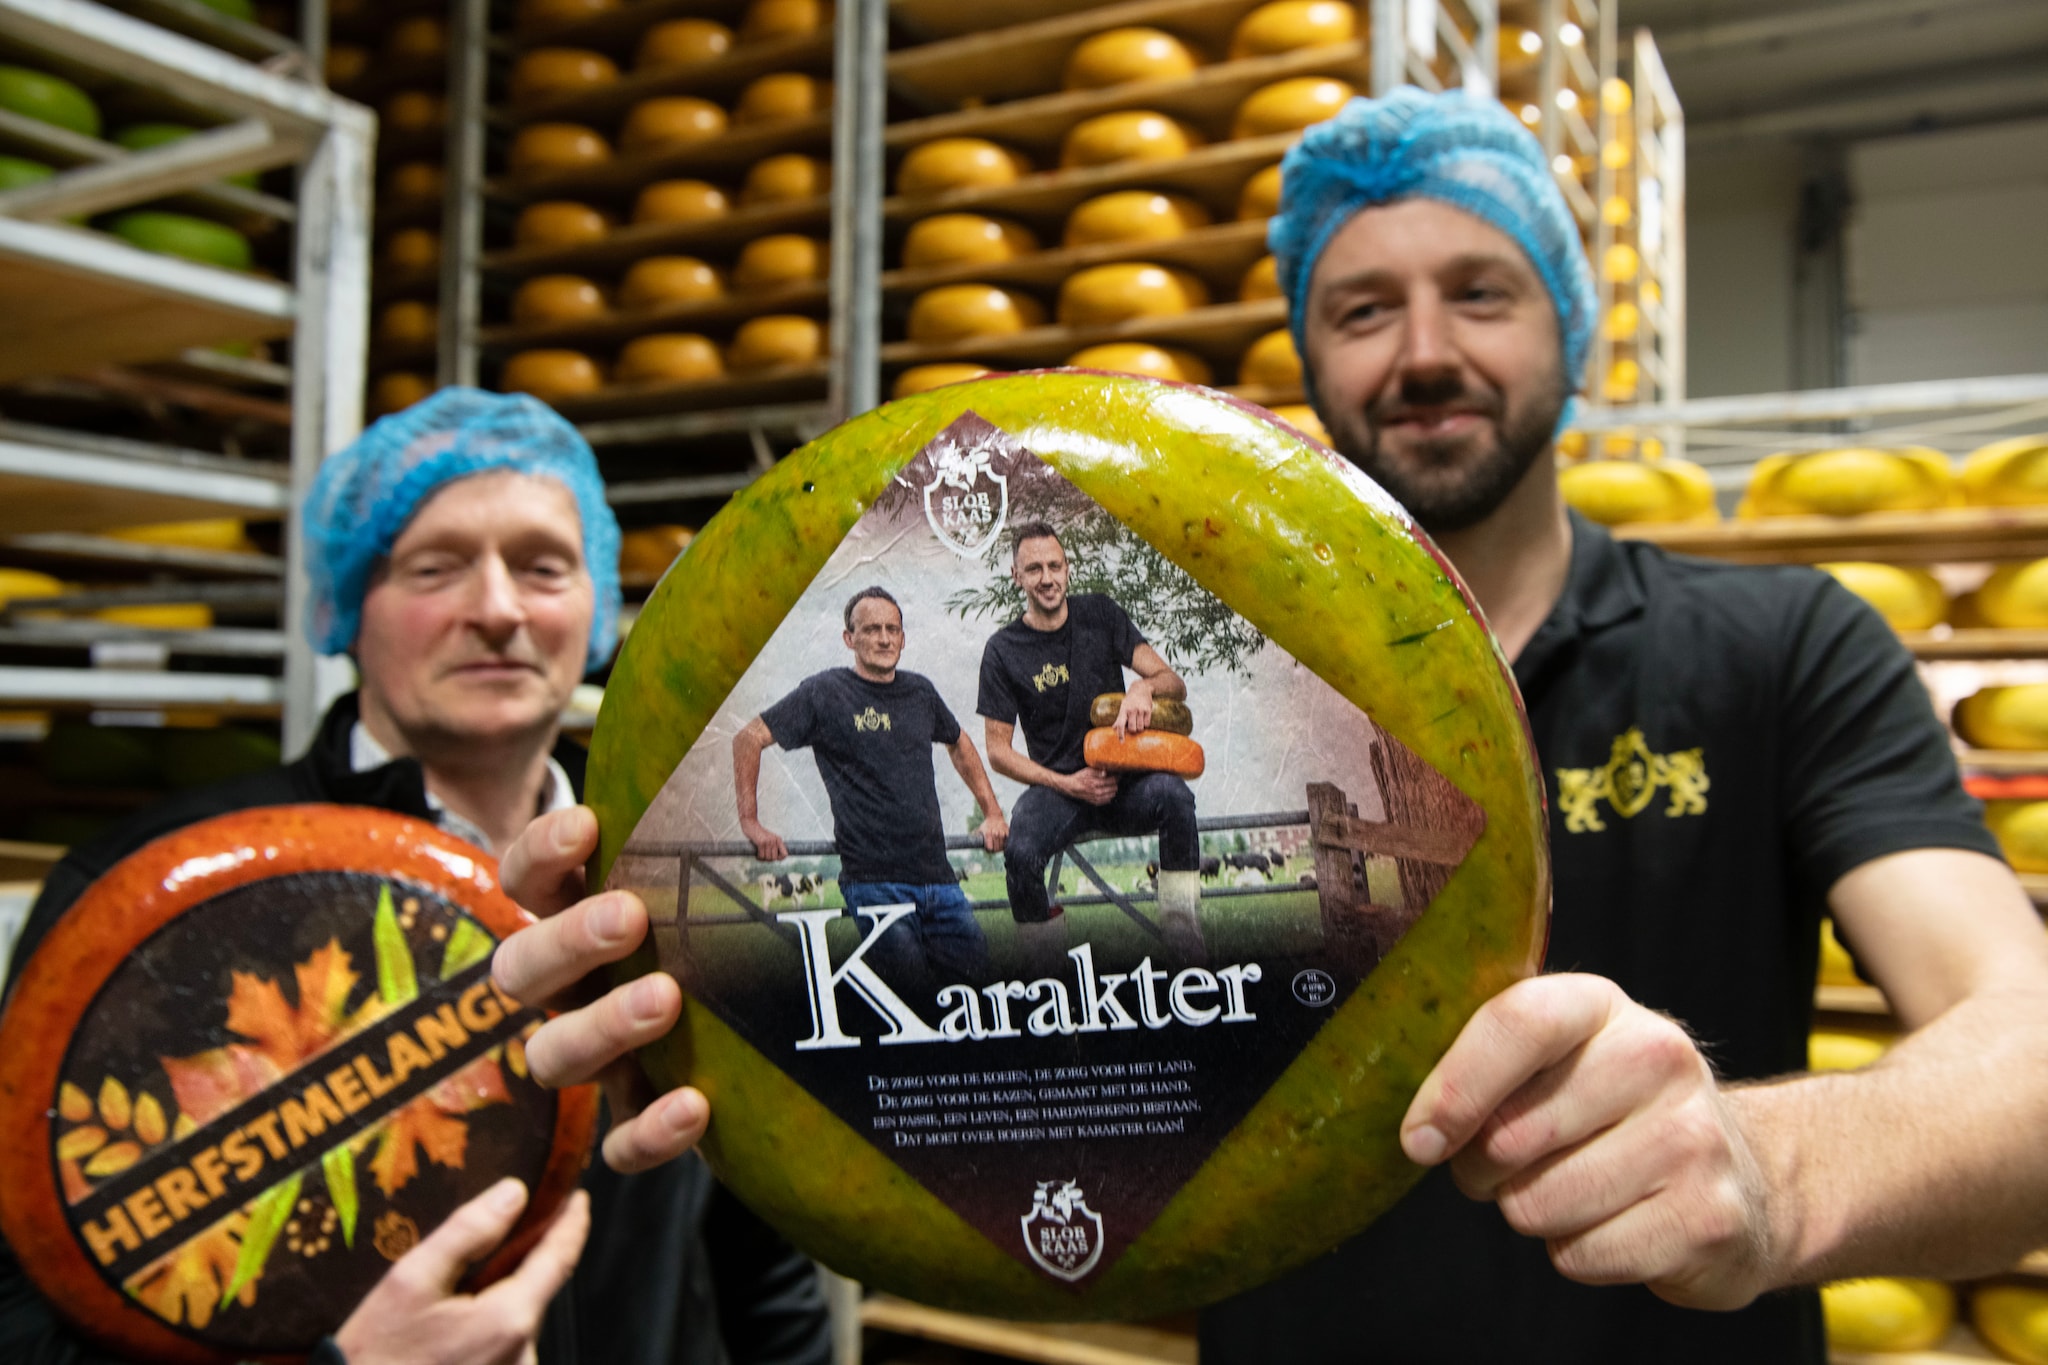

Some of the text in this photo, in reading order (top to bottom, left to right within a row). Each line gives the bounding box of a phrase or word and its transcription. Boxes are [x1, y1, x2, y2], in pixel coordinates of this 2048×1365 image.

[942, 492, 990, 512] SLOB
[943, 505, 992, 527] KAAS
[776, 902, 1263, 1051] Karakter
